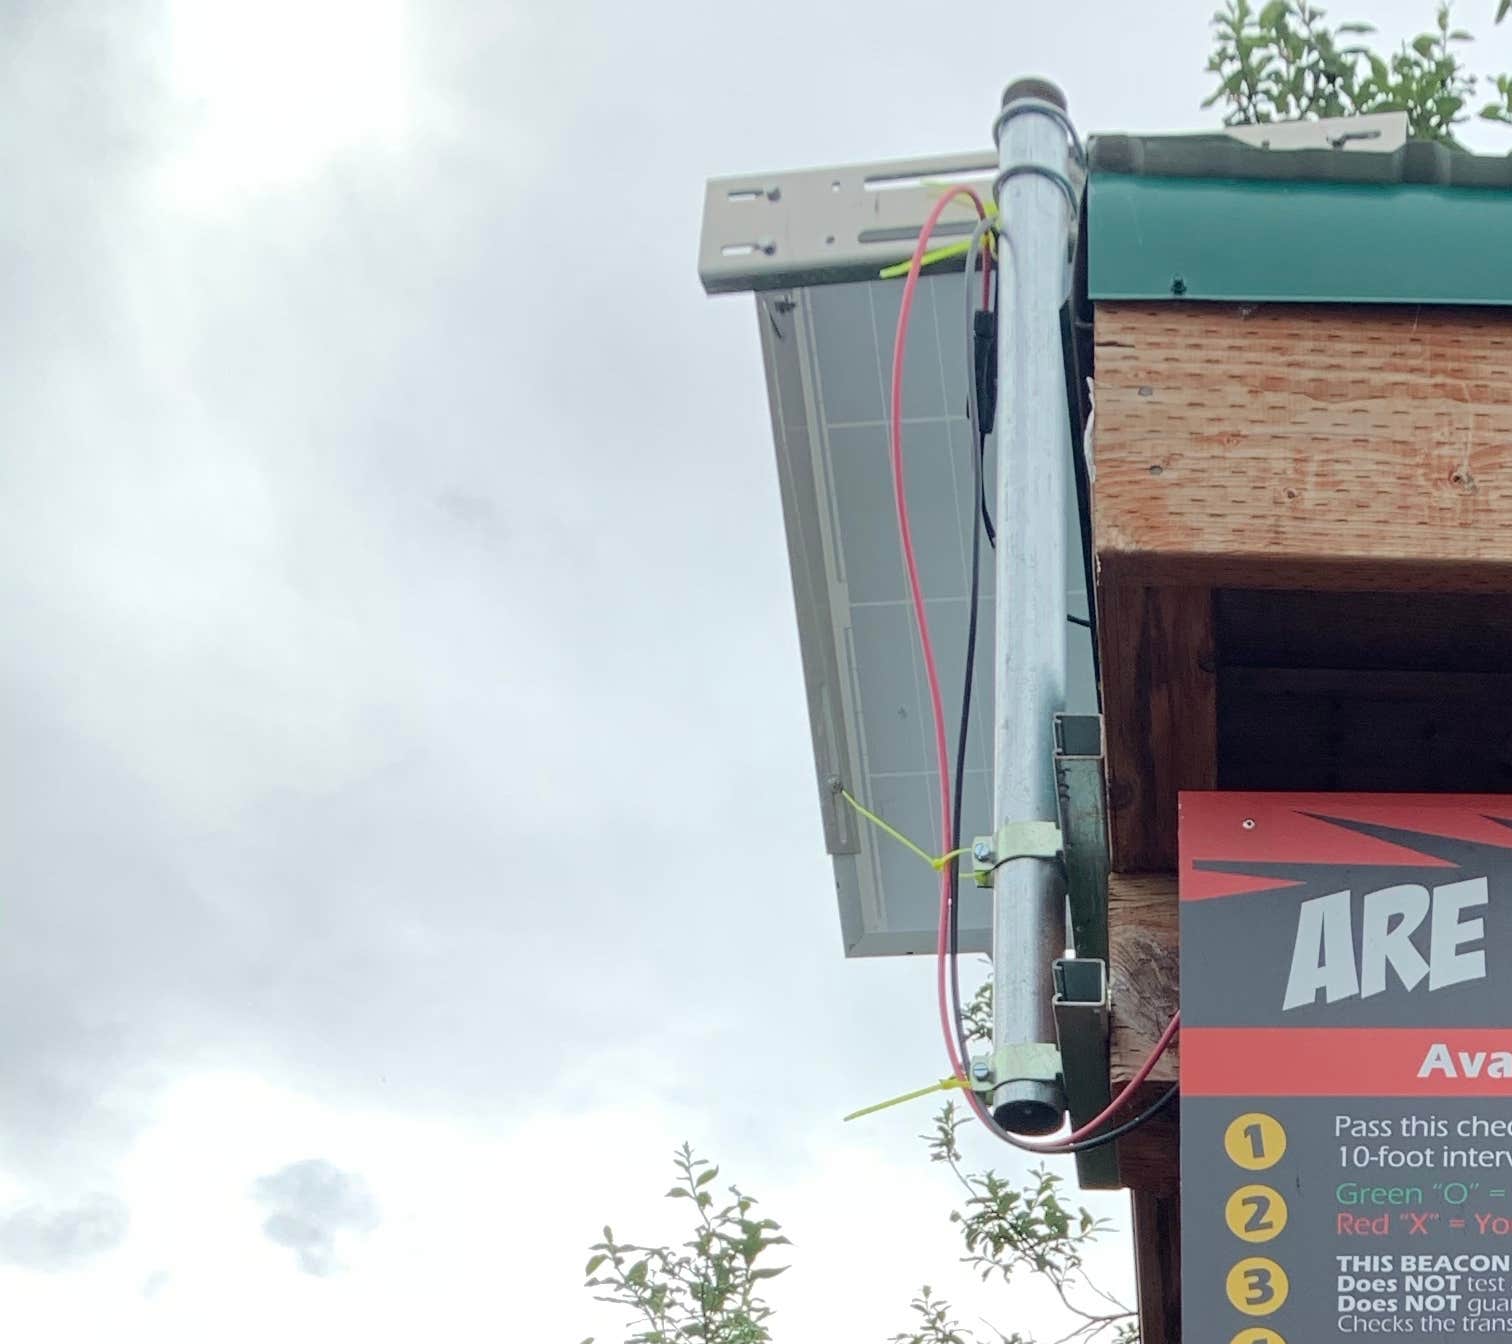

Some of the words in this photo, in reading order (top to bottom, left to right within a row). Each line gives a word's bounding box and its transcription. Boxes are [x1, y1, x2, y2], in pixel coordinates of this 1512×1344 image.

[1283, 876, 1489, 1011] ARE
[1336, 1116, 1391, 1136] Pass
[1401, 1116, 1448, 1136] this
[1341, 1146, 1434, 1167] 10-foot
[1337, 1256, 1392, 1272] THIS
[1401, 1255, 1509, 1271] BEACON
[1338, 1276, 1397, 1292] Does
[1405, 1275, 1461, 1291] NOT
[1468, 1277, 1504, 1291] test
